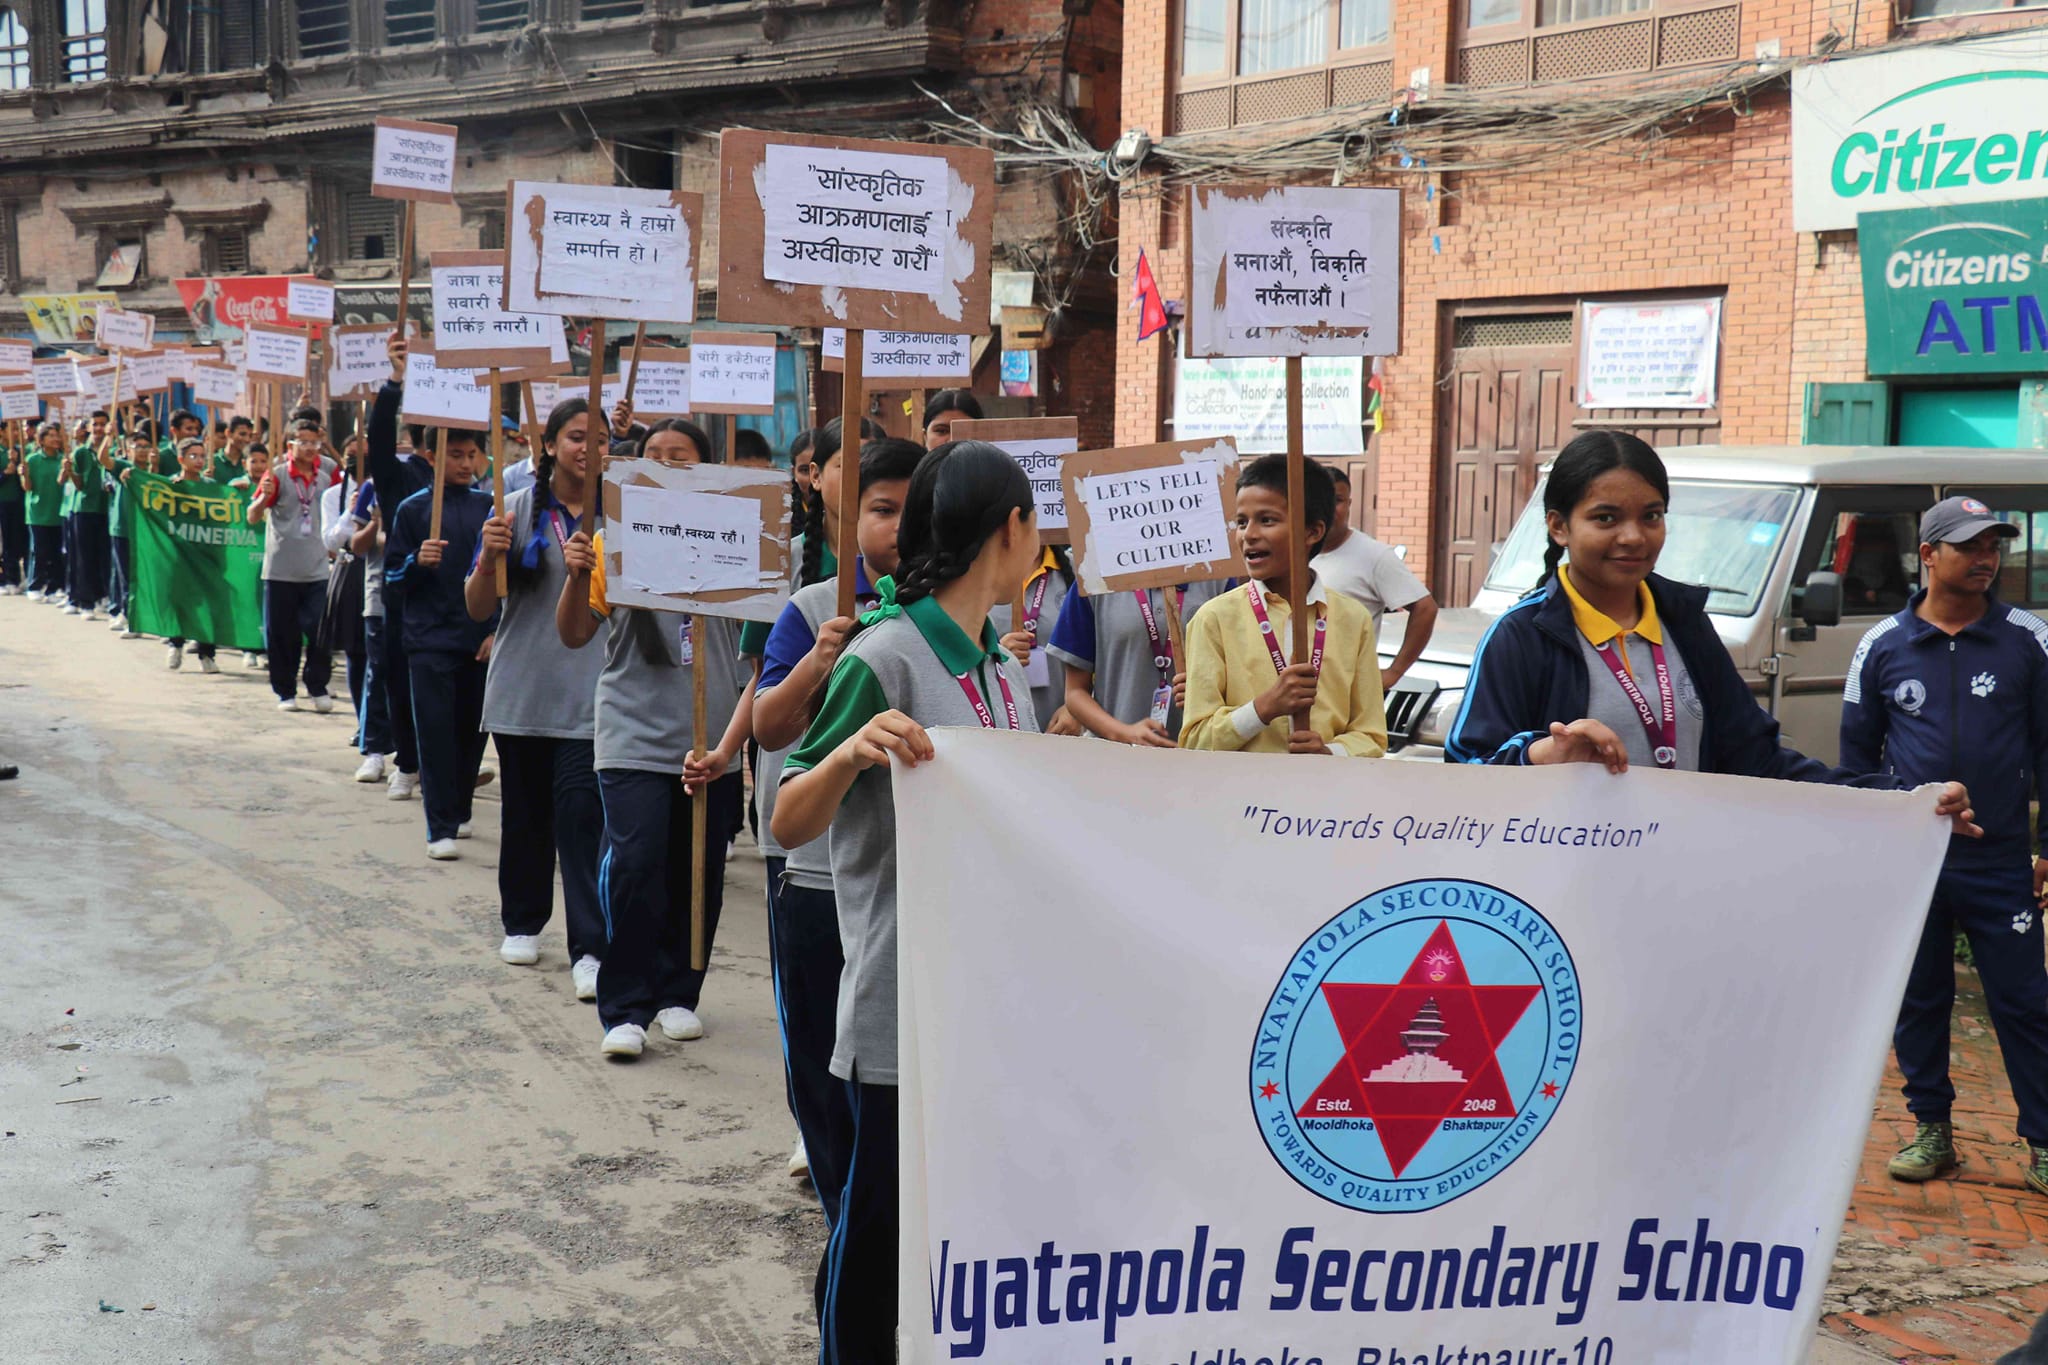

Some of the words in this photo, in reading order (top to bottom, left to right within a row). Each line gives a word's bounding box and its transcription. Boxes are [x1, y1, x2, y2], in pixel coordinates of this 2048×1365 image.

[553, 210, 612, 228] स्वास्थ्य
[620, 209, 632, 229] नै
[640, 214, 676, 234] हाम्रो
[796, 203, 933, 238] आक्रमणलाई
[1271, 214, 1333, 247] संस्कृति
[566, 239, 620, 259] सम्पत्ति
[629, 243, 645, 264] हो
[782, 237, 884, 267] अस्वीकार
[1310, 248, 1368, 282] विकृति
[1885, 248, 2031, 289] Citizens
[1915, 295, 2048, 356] ATM
[871, 349, 931, 366] अस्वीकार
[1302, 382, 1349, 398] ollection
[1160, 471, 1207, 490] FELL
[1108, 499, 1174, 521] PROUD
[1180, 493, 1204, 510] OF
[168, 520, 257, 546] MINERVA
[632, 522, 653, 535] सफा
[1140, 520, 1182, 540] OUR
[1117, 538, 1213, 567] CULTURE!
[1616, 669, 1654, 725] NYATAPOLA
[1656, 664, 1674, 721] NYATAPOLA
[1243, 805, 1383, 841] "Towards
[1392, 815, 1494, 848] Quality
[1502, 817, 1659, 848] Education"
[1256, 903, 1375, 1069] NYATAPOLA
[1381, 886, 1554, 953] SECONDARY
[1544, 951, 1577, 1071] SCHOOL
[1316, 1098, 1353, 1112] Estd.
[1463, 1098, 1497, 1112] 2048
[1303, 1118, 1374, 1132] Mooldhoka
[1442, 1119, 1505, 1133] Bhaktapur
[1270, 1110, 1337, 1186] TOWARDS
[1341, 1180, 1429, 1203] QUALITY
[1437, 1111, 1539, 1195] EDUCATION
[1269, 1225, 1599, 1326] Secondary
